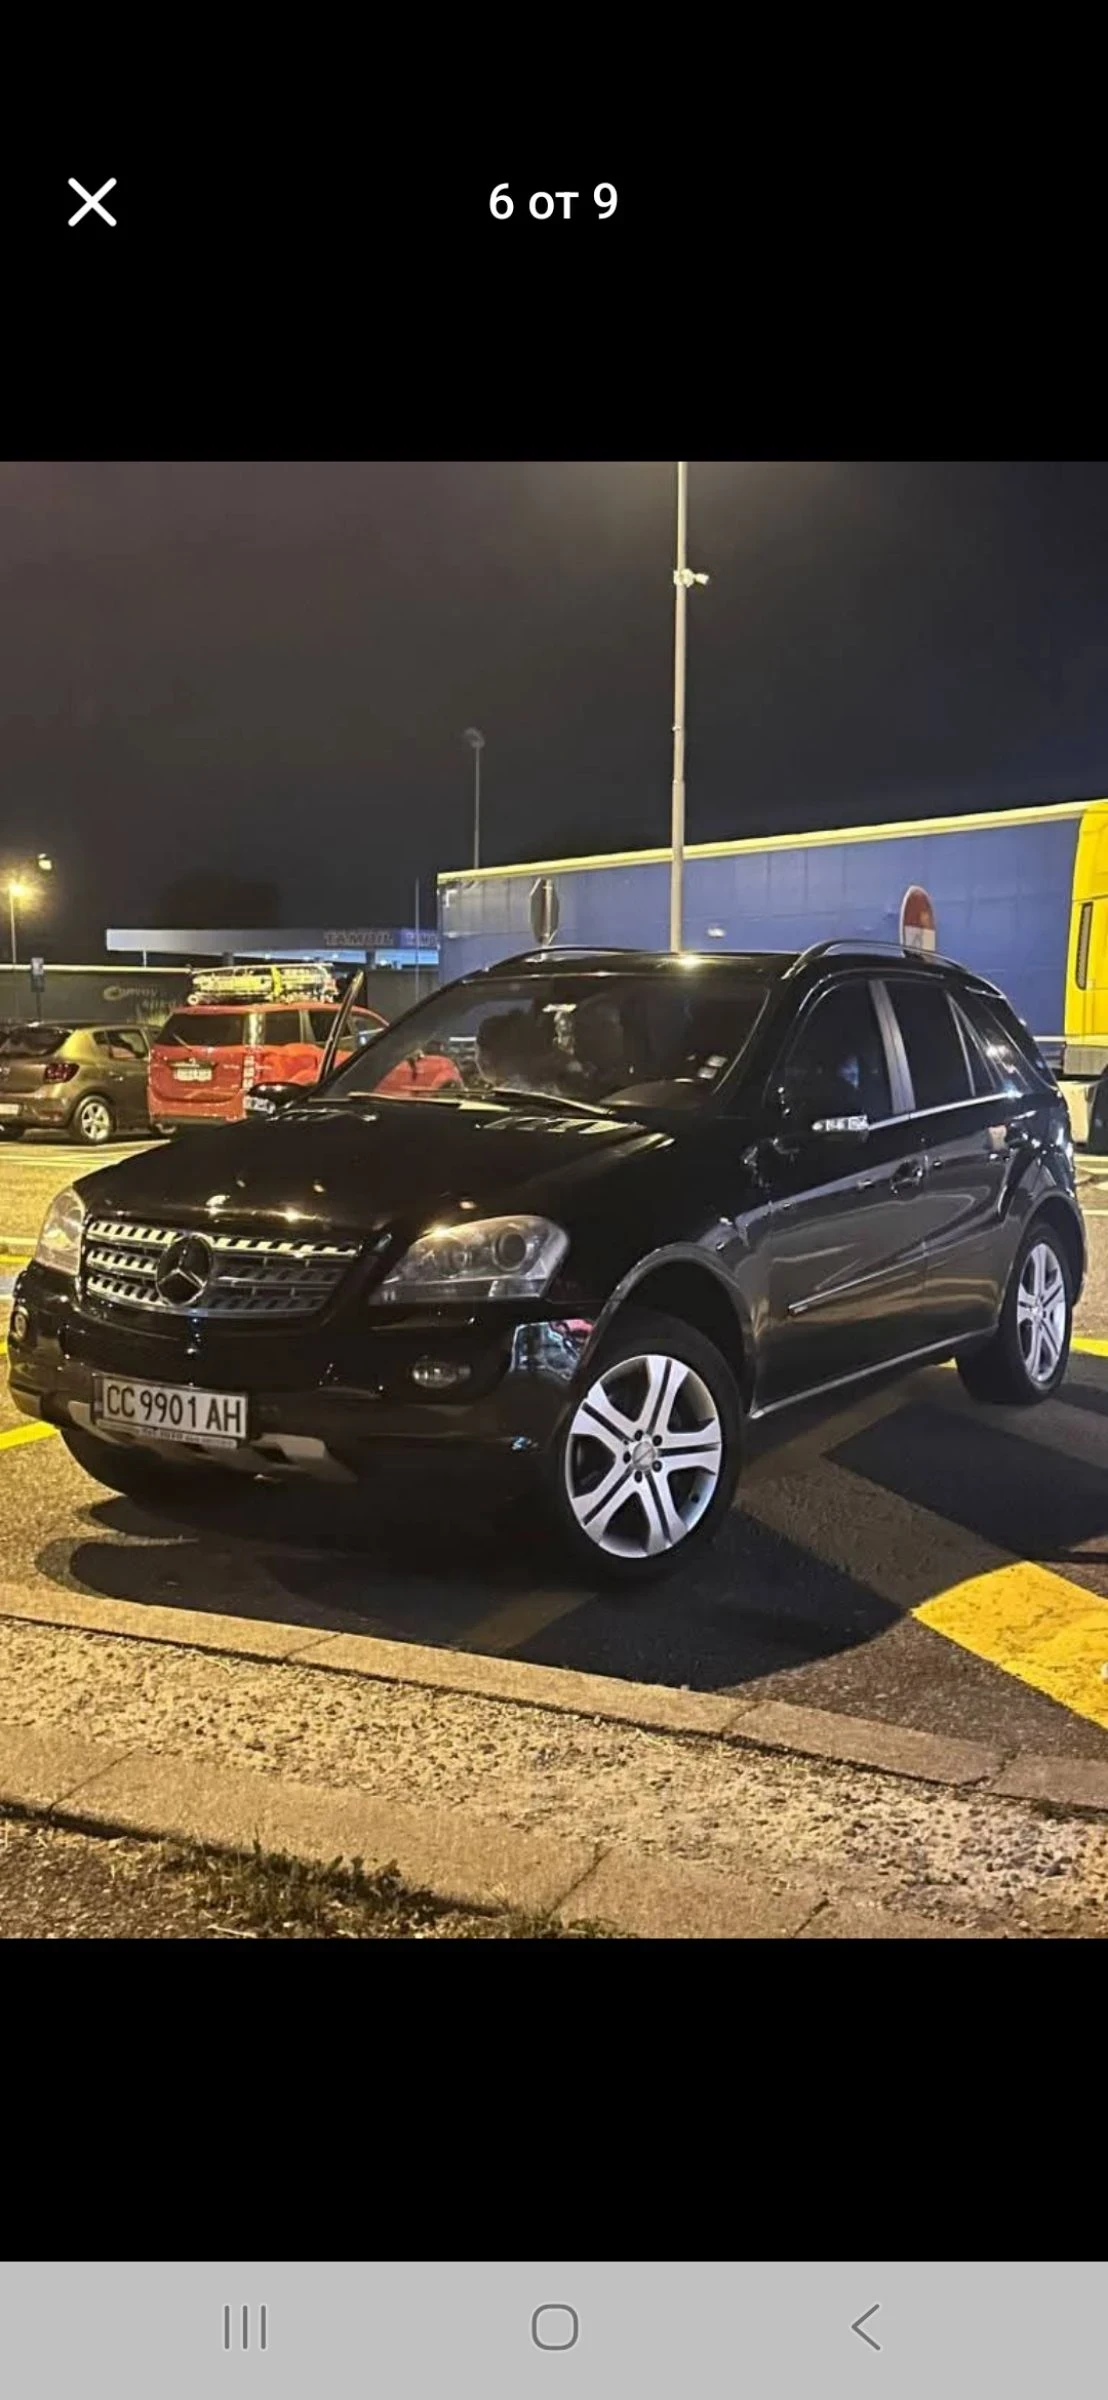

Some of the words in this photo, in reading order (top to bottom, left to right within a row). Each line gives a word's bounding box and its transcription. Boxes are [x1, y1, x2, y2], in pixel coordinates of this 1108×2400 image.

[107, 1385, 136, 1417] CC
[139, 1390, 197, 1429] 9901
[205, 1398, 242, 1434] AH
